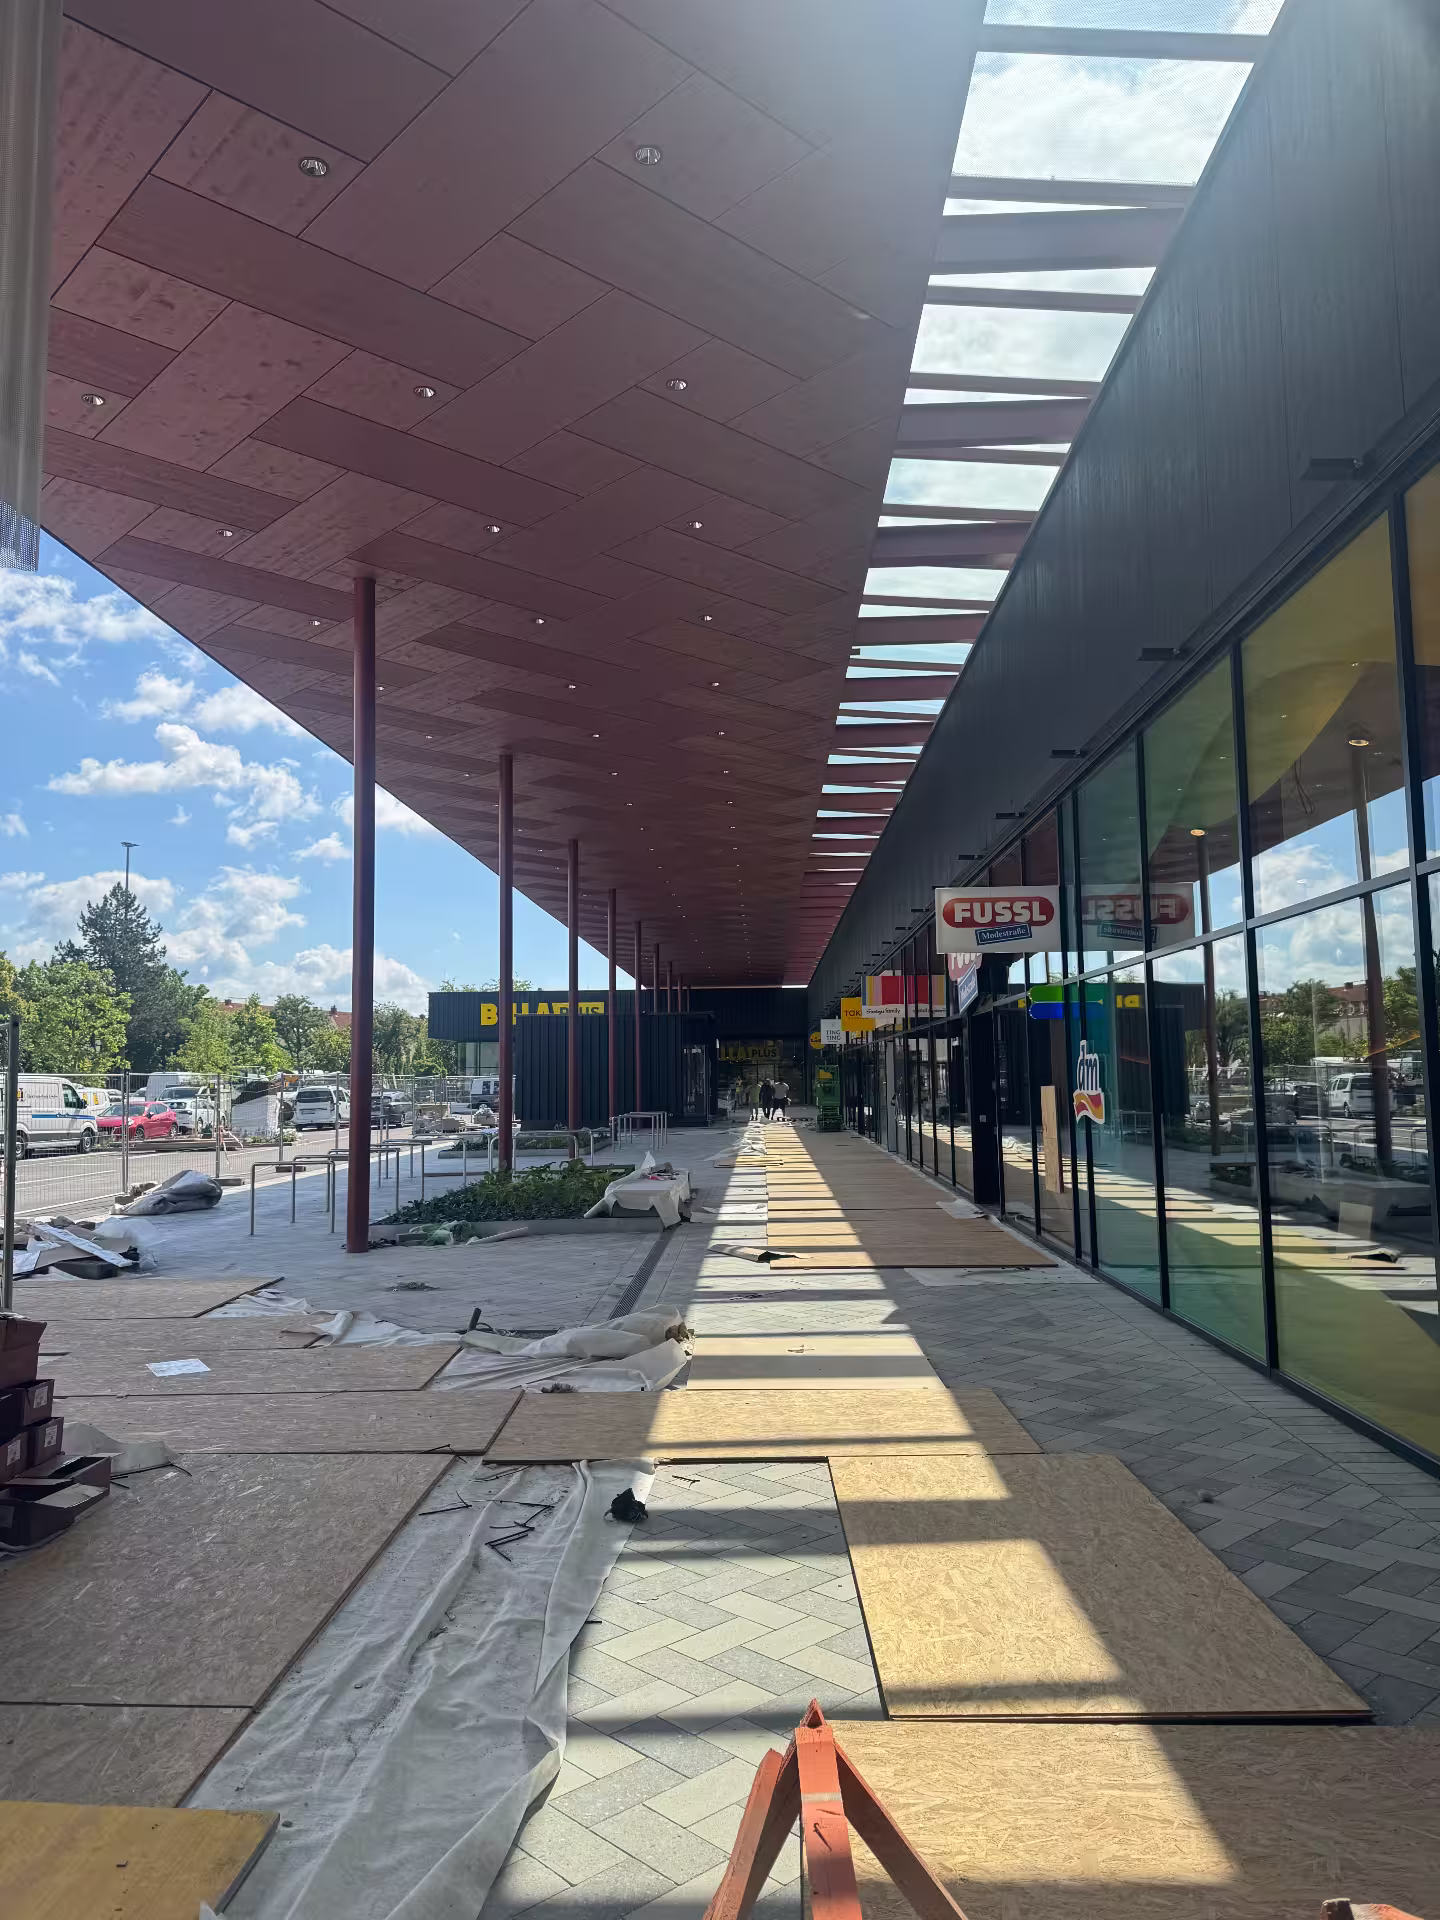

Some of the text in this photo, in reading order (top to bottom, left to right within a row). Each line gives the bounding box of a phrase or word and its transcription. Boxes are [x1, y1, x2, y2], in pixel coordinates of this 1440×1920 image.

[954, 901, 1047, 923] FUSSL
[981, 928, 1026, 940] Modestraße
[751, 1048, 777, 1058] PLUS
[1078, 1043, 1099, 1091] dm
